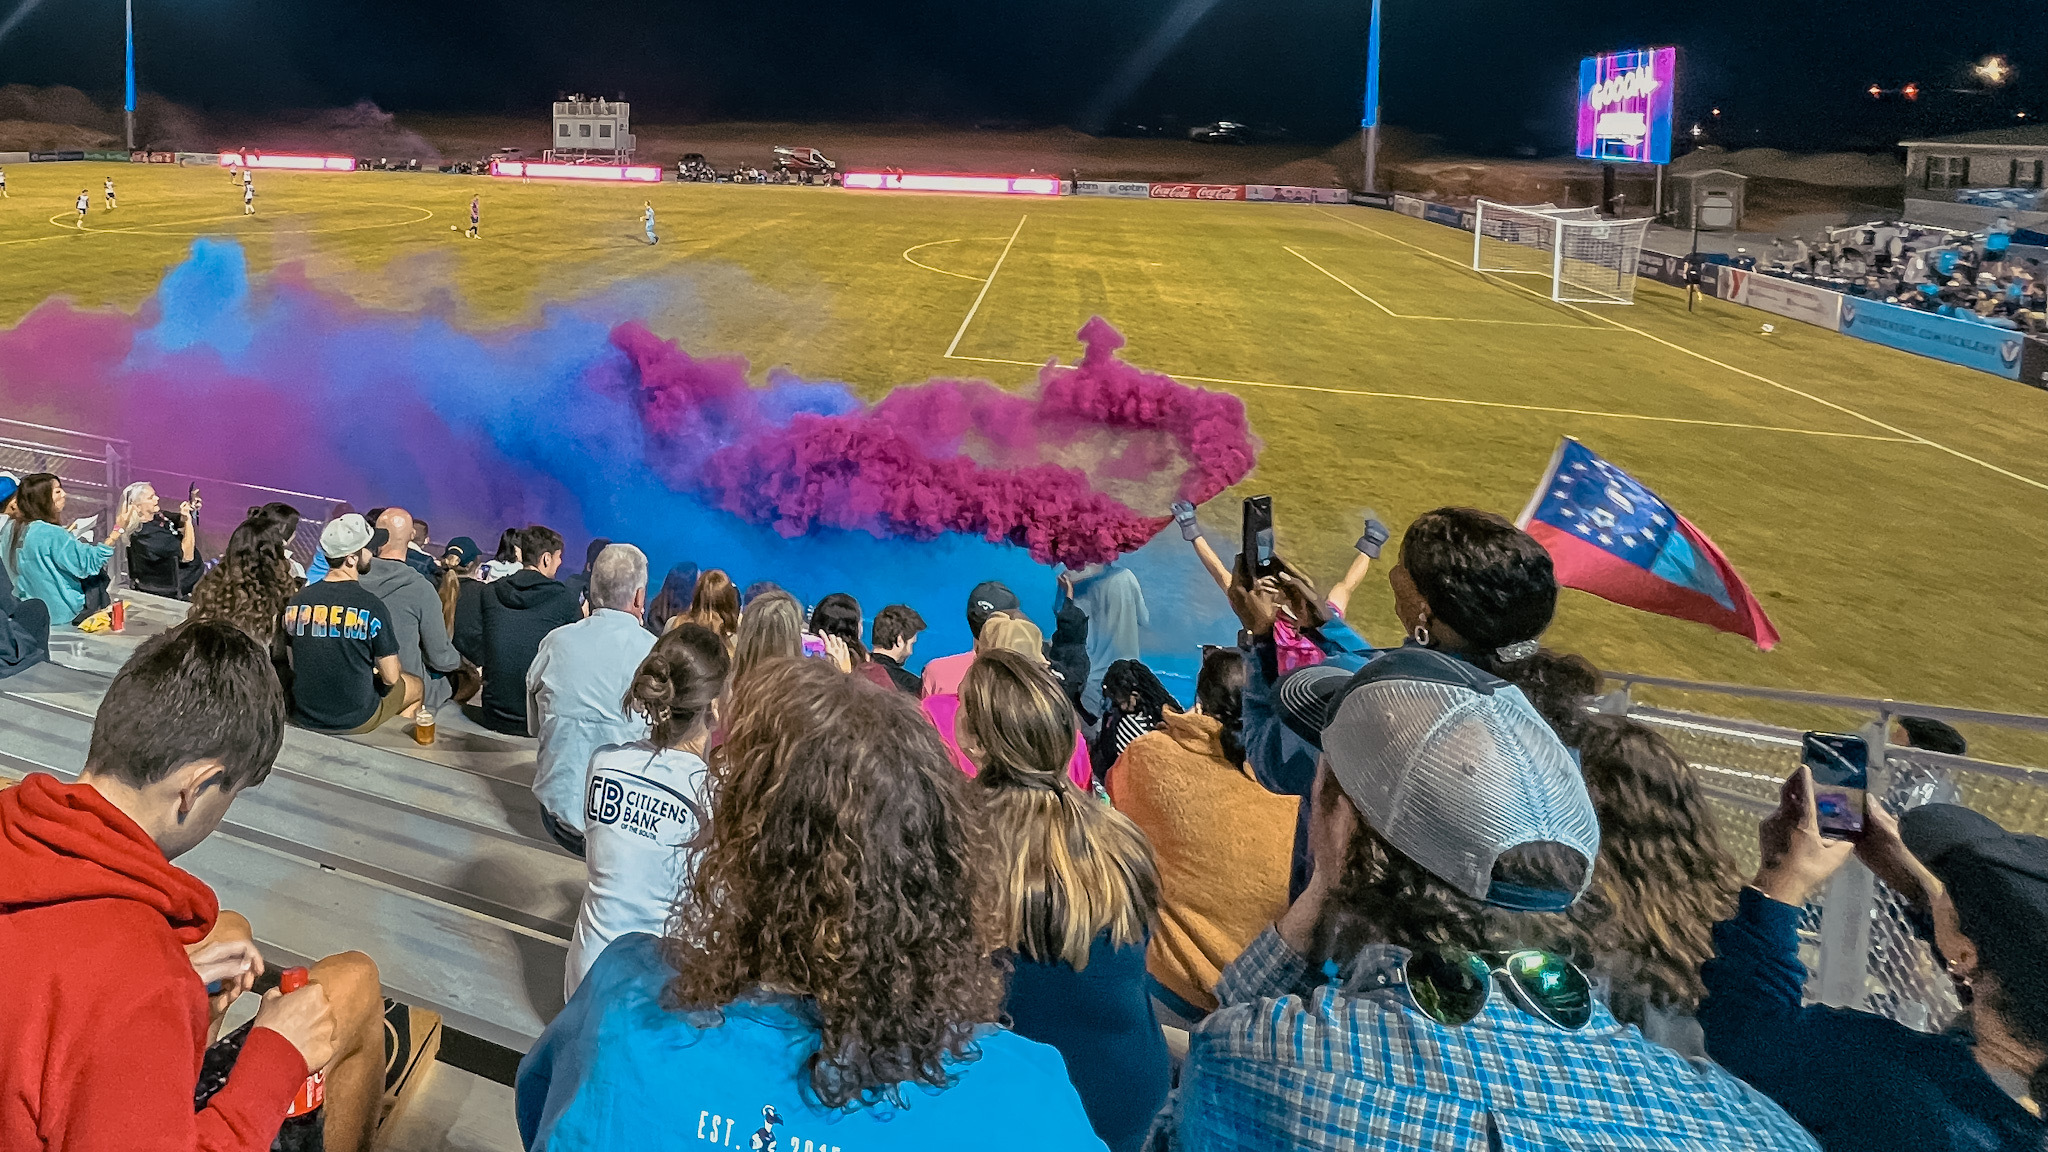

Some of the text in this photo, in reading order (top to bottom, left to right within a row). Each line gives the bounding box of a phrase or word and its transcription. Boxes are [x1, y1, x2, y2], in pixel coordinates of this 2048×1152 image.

[1118, 184, 1148, 193] optim
[282, 604, 381, 640] UPREM
[623, 806, 662, 833] BANK
[626, 791, 688, 824] CITIZENS
[629, 826, 638, 834] THE
[697, 1110, 741, 1151] EST.
